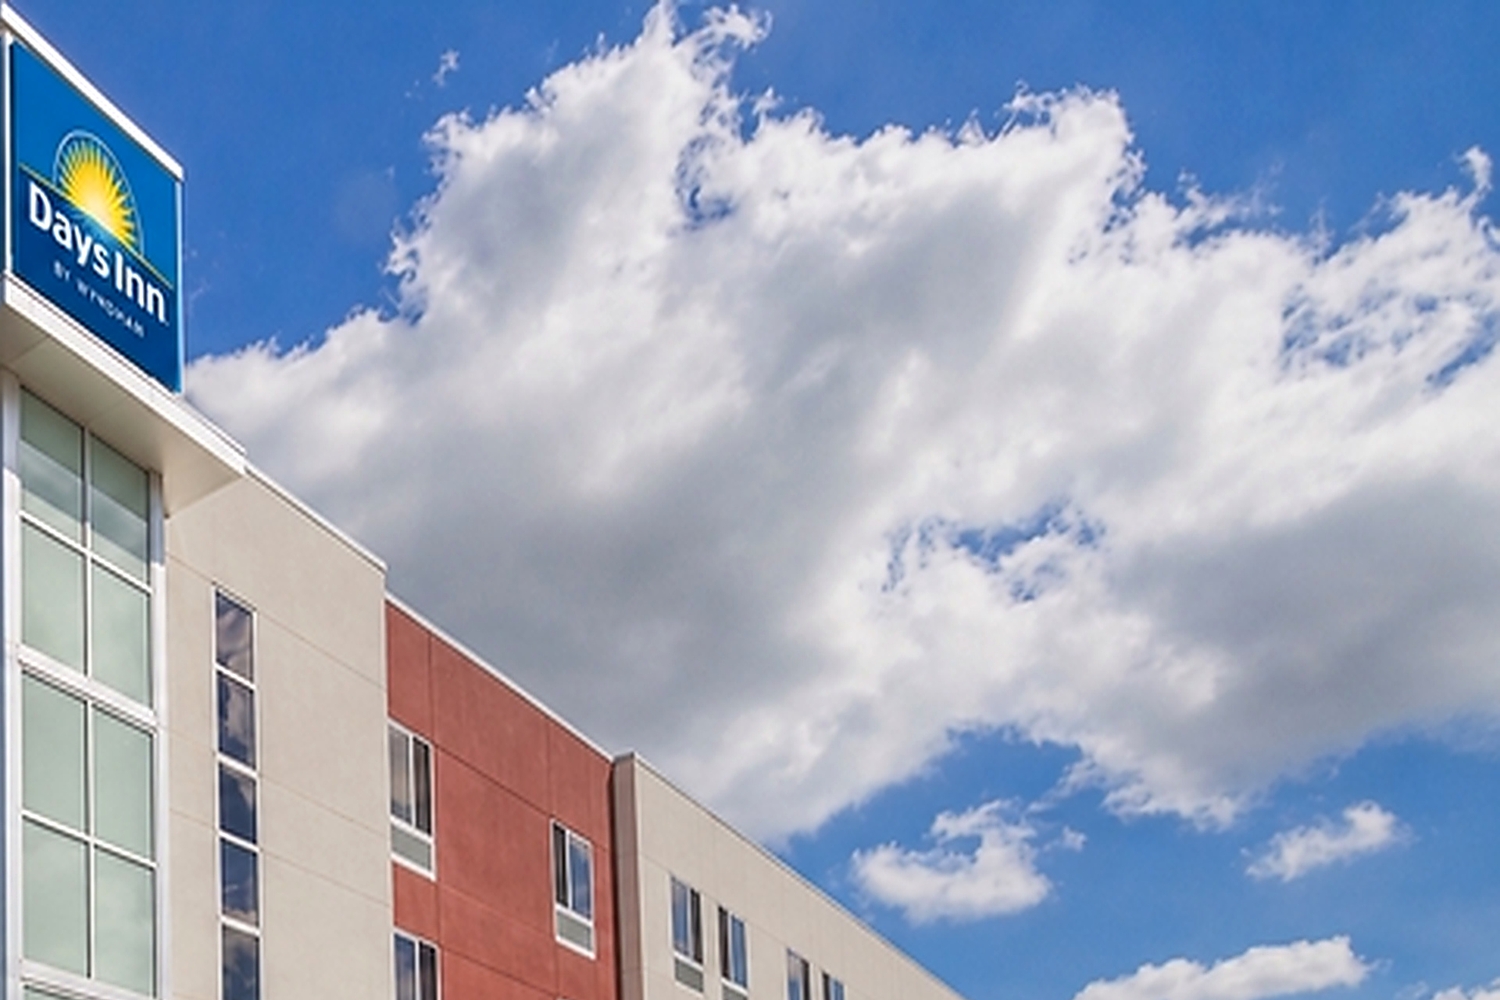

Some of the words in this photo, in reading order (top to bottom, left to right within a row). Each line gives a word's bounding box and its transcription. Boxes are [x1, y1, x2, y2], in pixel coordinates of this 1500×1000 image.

[29, 180, 110, 279] Days
[114, 250, 165, 323] Inn
[54, 260, 70, 282] BY
